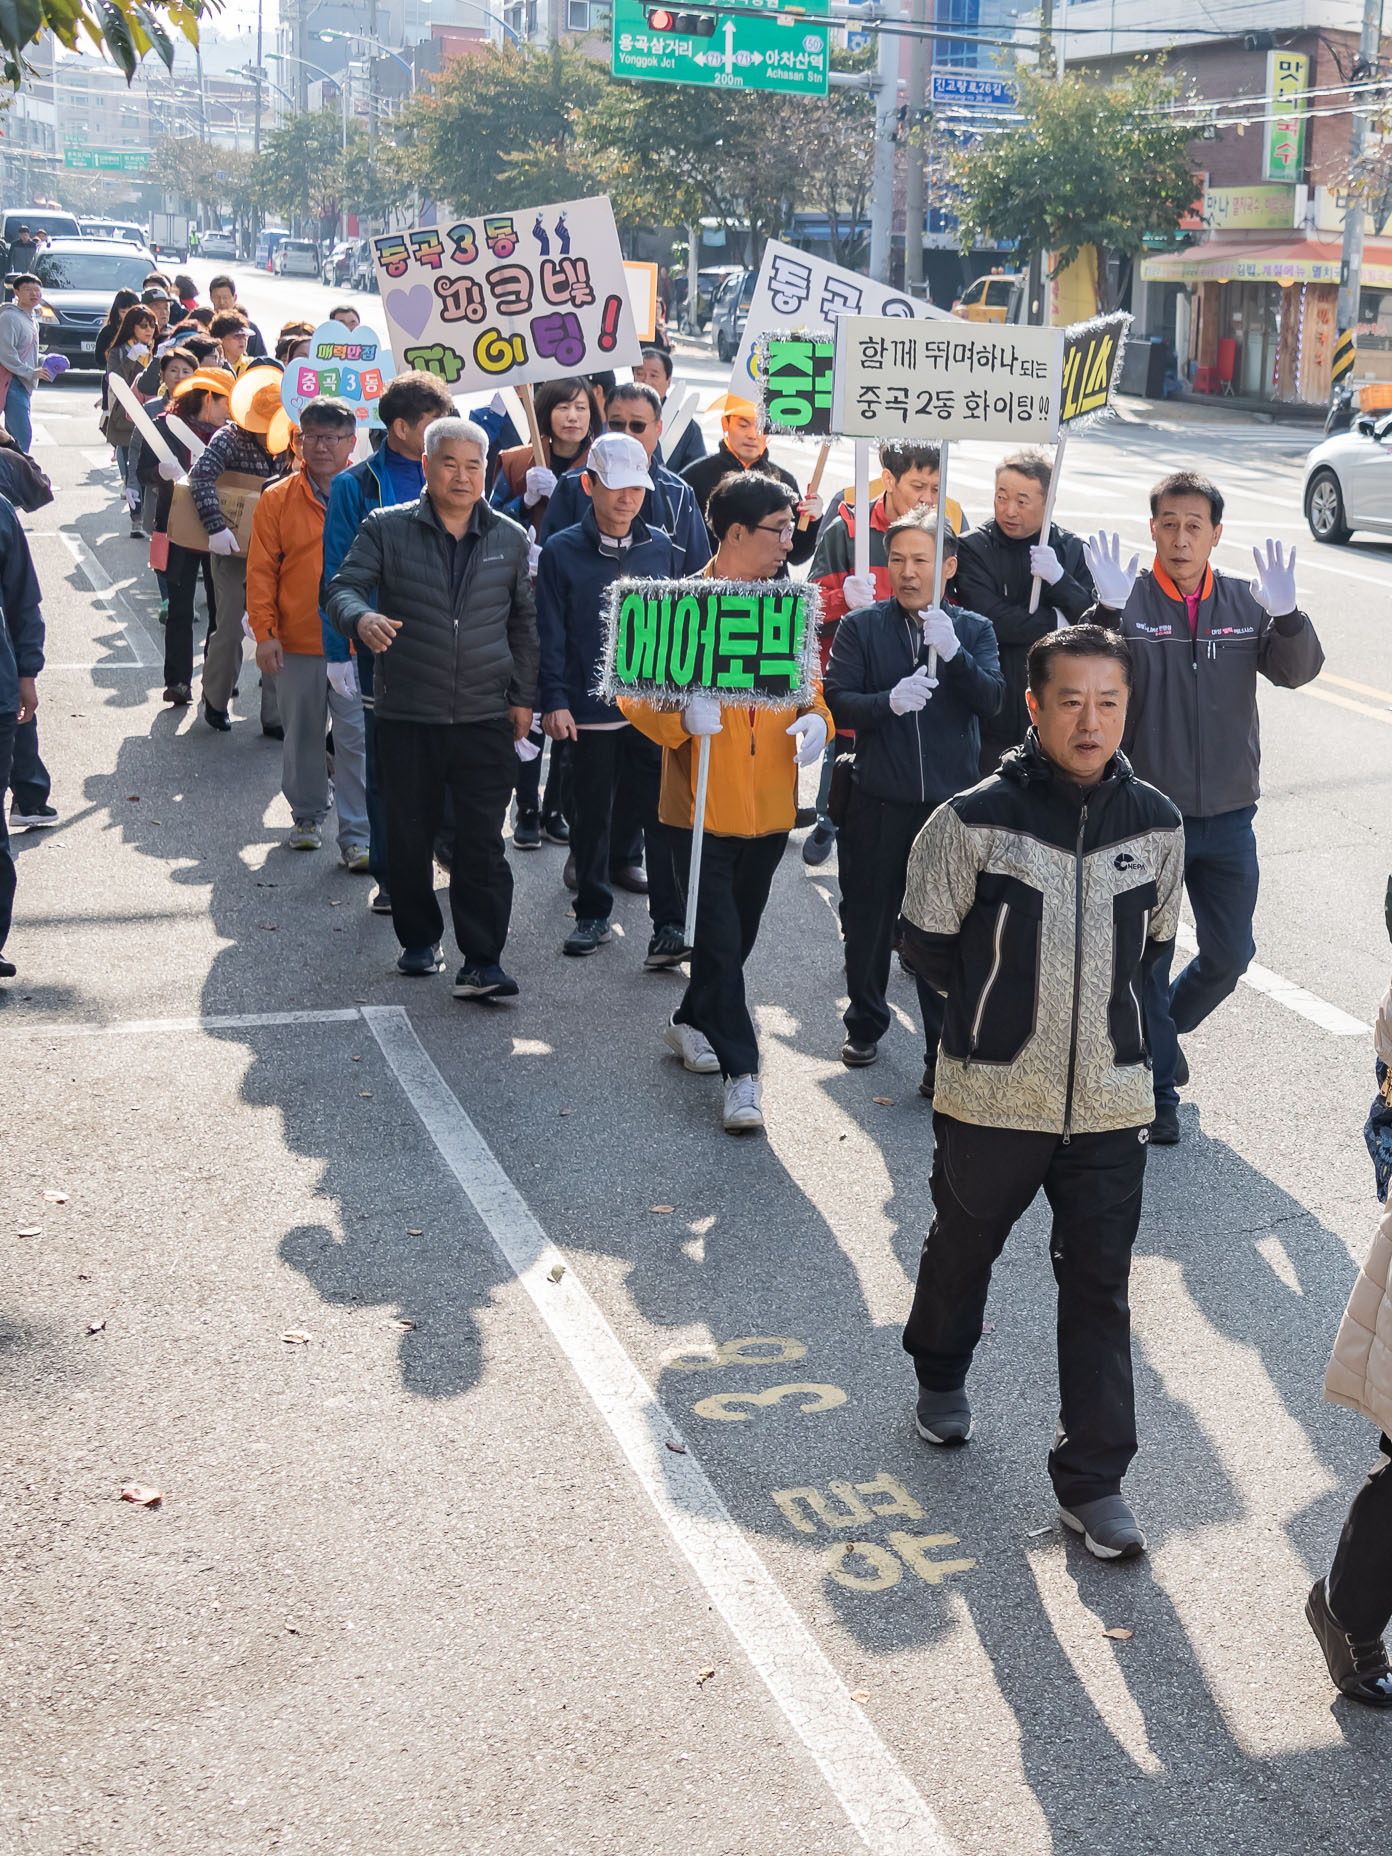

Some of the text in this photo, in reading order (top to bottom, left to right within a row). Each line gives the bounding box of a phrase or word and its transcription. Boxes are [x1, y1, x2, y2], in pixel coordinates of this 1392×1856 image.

[619, 33, 693, 58] 용곡삼거리
[804, 39, 821, 51] 50
[619, 52, 676, 69] Yonggok Jct
[765, 49, 824, 71] 아차산역
[714, 72, 744, 87] 200m
[766, 67, 823, 83] Achasan Stn
[374, 216, 519, 278] 중곡3동
[434, 257, 596, 324] 핑크빛
[316, 343, 377, 361] 매력만점
[858, 336, 917, 371] 함께
[301, 371, 379, 393] 중곡3동
[1061, 334, 1113, 421] 니스
[856, 386, 956, 423] 중곡2동
[616, 593, 808, 690] 에어로빅
[1127, 863, 1146, 871] NEPA
